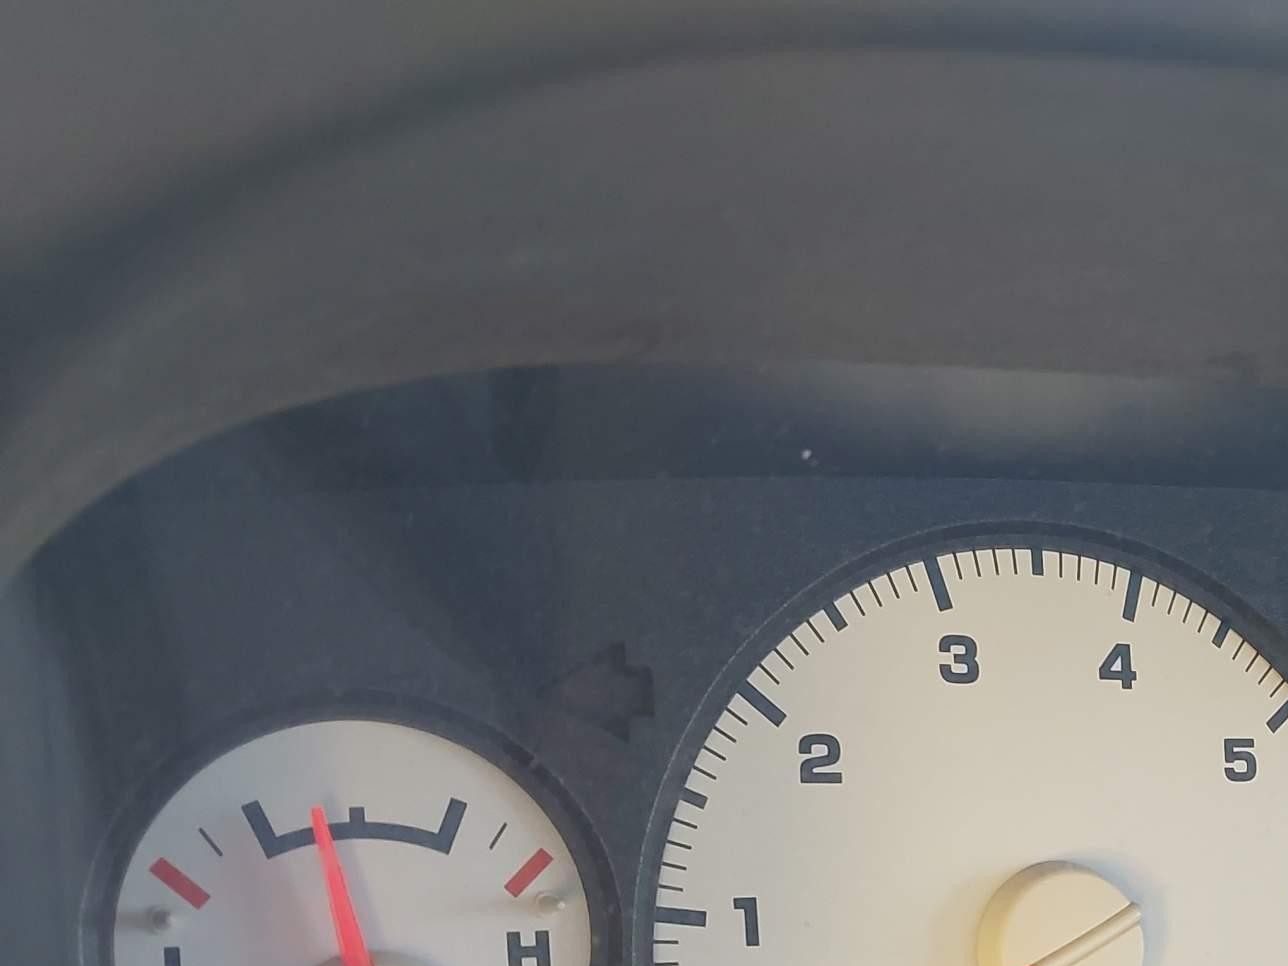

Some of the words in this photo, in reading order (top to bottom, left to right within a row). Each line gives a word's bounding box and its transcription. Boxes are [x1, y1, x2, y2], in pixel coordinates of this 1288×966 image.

[938, 634, 980, 685] 3
[1098, 643, 1137, 690] 4
[798, 733, 843, 784] 2
[1223, 738, 1257, 783] 5
[732, 896, 760, 947] 1
